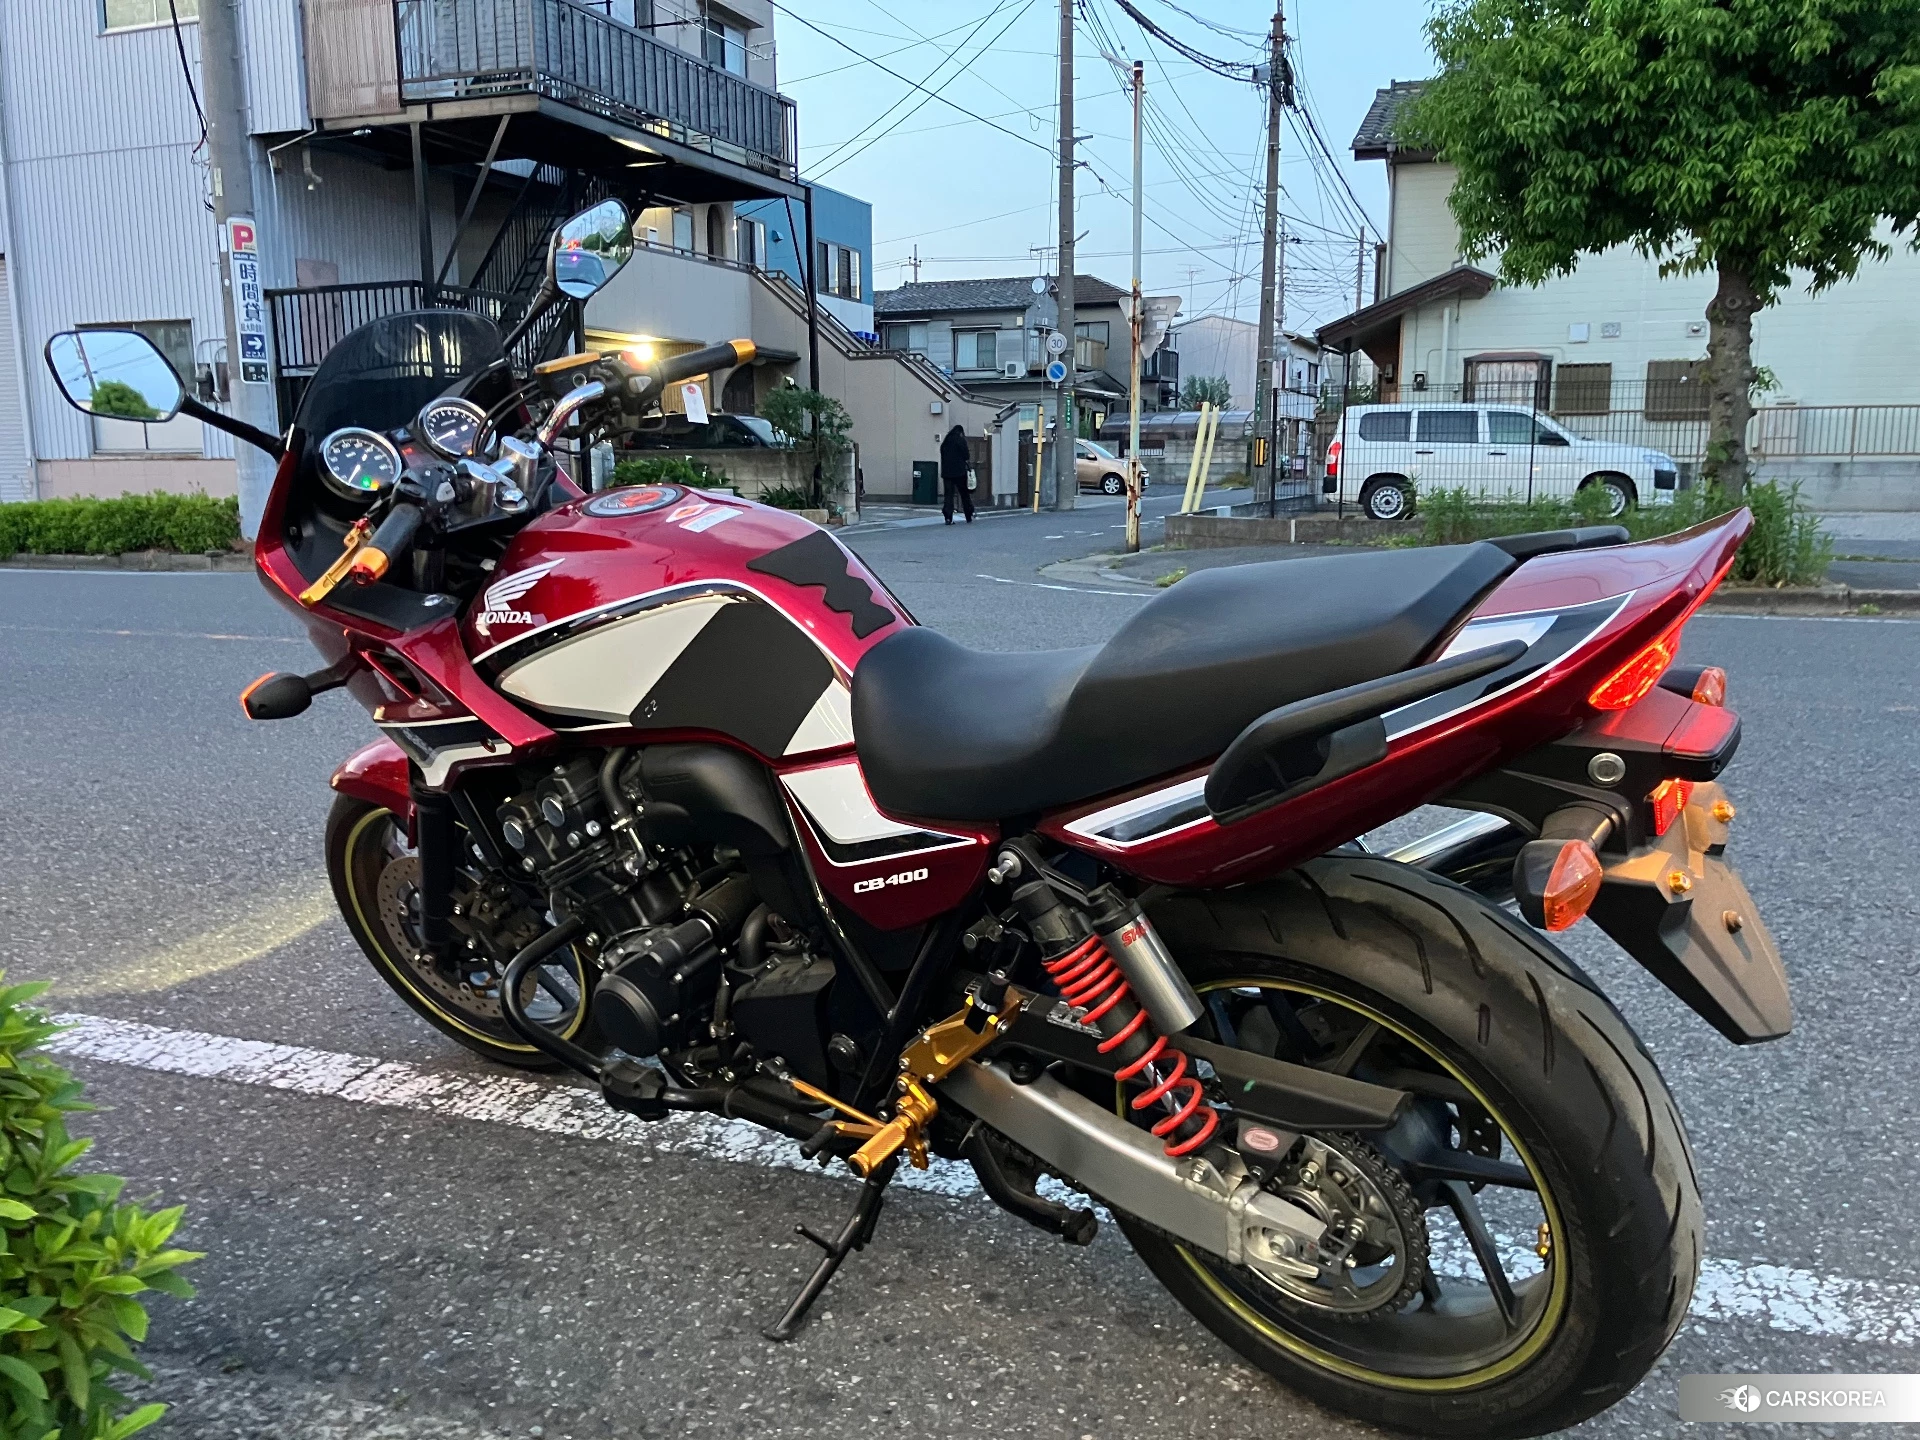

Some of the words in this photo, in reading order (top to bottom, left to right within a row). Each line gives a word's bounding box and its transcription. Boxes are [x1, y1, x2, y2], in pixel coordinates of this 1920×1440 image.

[233, 224, 254, 250] P
[240, 263, 262, 322] 時間貸
[1051, 339, 1063, 349] 30
[475, 611, 532, 625] HONDA
[853, 868, 928, 894] CB400
